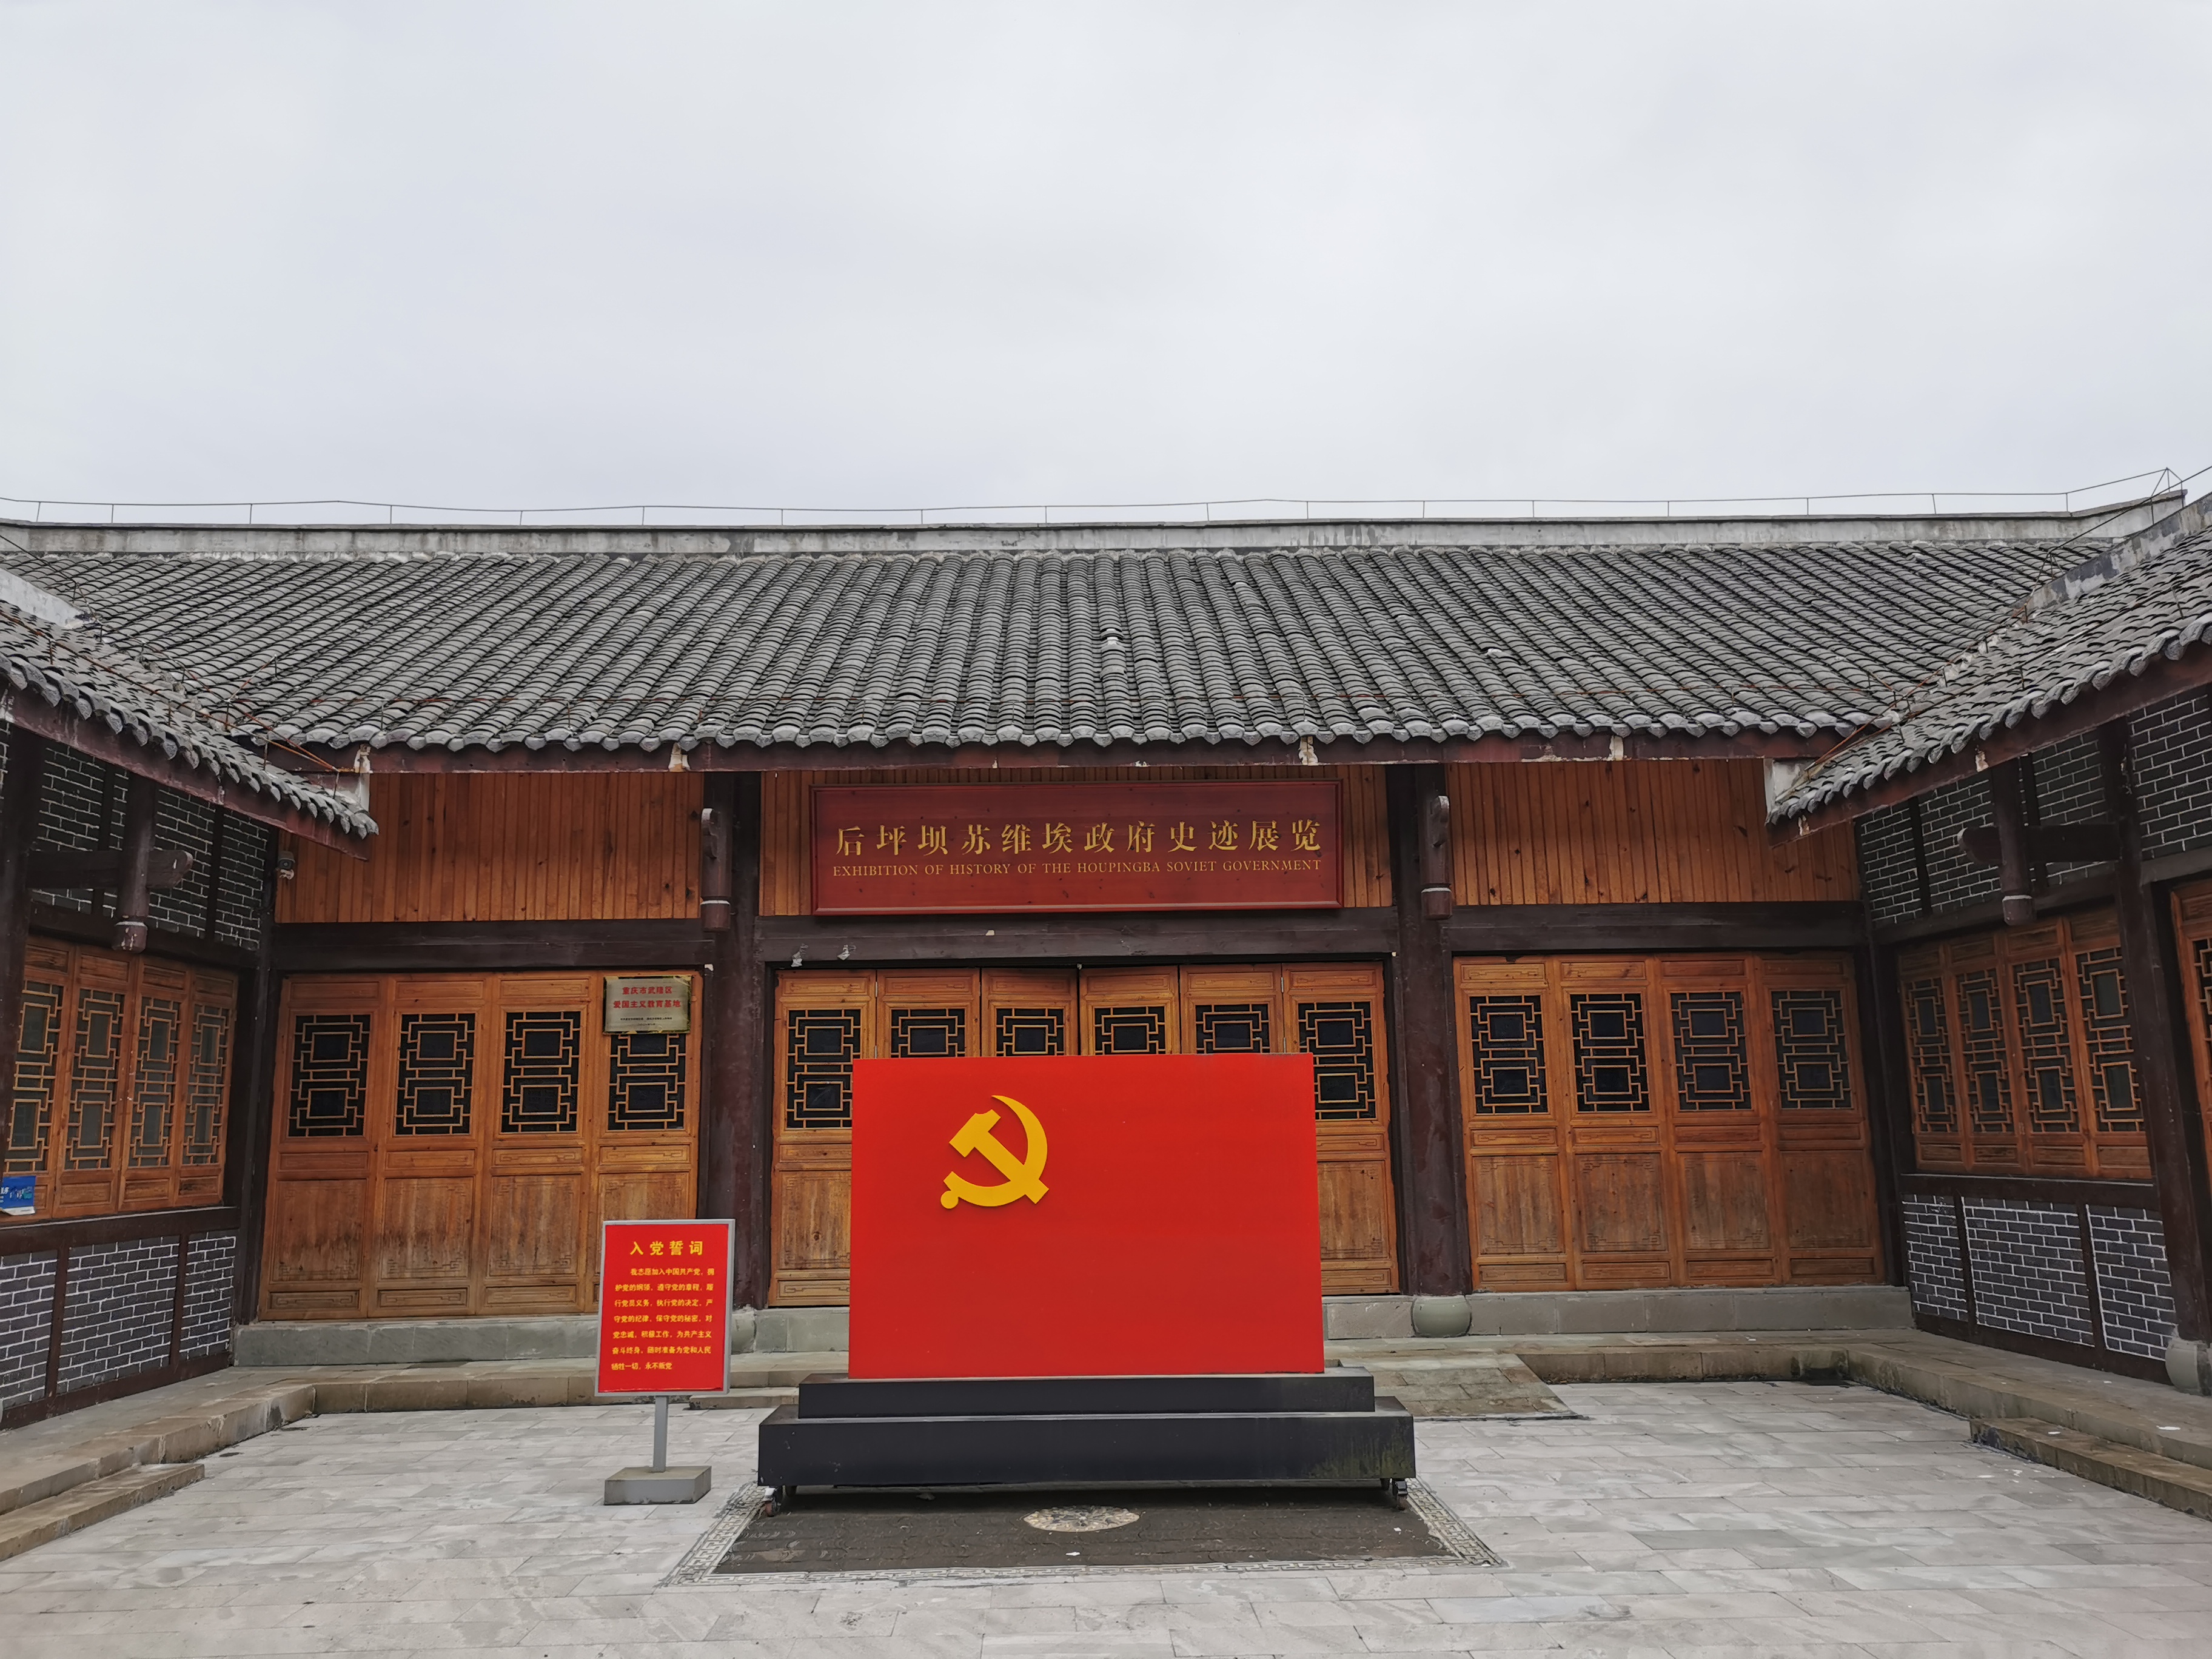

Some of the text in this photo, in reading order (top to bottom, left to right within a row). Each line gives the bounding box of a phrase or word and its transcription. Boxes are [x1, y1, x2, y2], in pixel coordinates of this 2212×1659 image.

[836, 819, 1321, 856] 后坪坝苏维埃政府史迹展览
[833, 860, 1321, 877] EXHIBITION OF HISTORY OF THE HOUPINGBA SOVIET GOVERNMENT
[622, 986, 672, 995] 重庆市武隆区
[613, 999, 682, 1009] 爱国主义教育基地
[629, 1240, 703, 1256] 入党誓词
